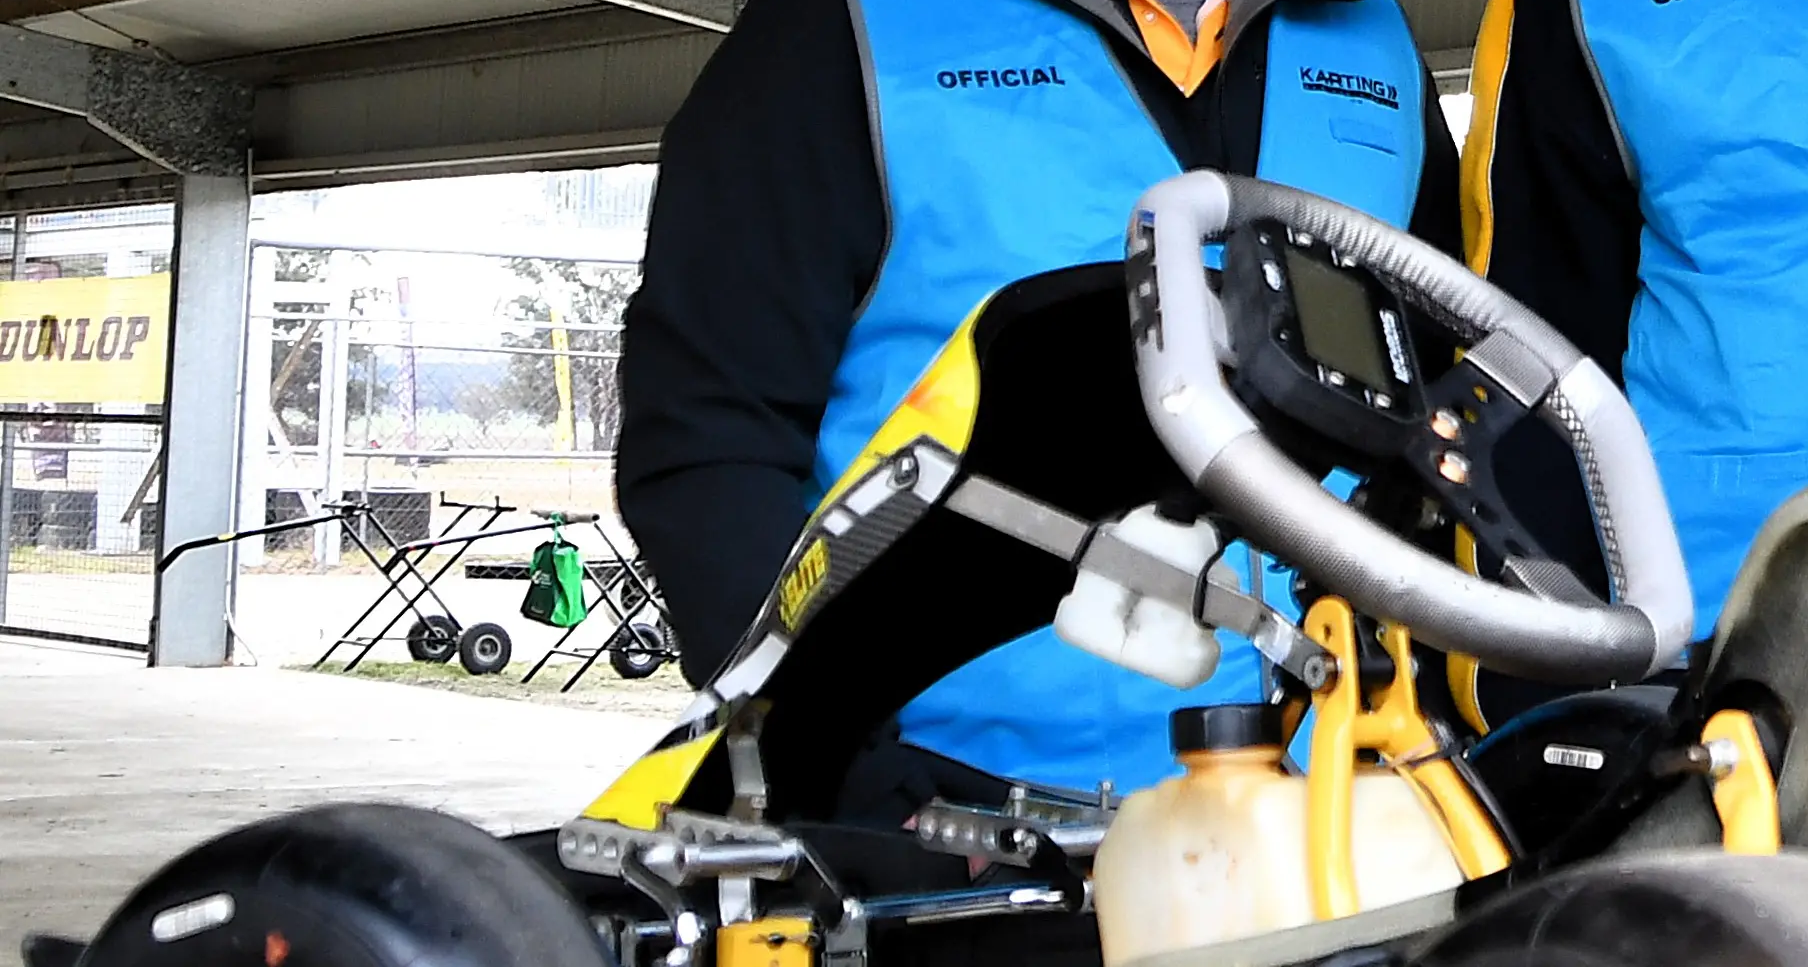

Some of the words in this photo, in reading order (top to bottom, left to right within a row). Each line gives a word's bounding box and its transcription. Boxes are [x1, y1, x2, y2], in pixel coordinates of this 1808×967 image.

[936, 65, 1066, 89] OFFICIAL
[1300, 65, 1386, 97] KARTING
[0, 315, 151, 362] DUNLOP
